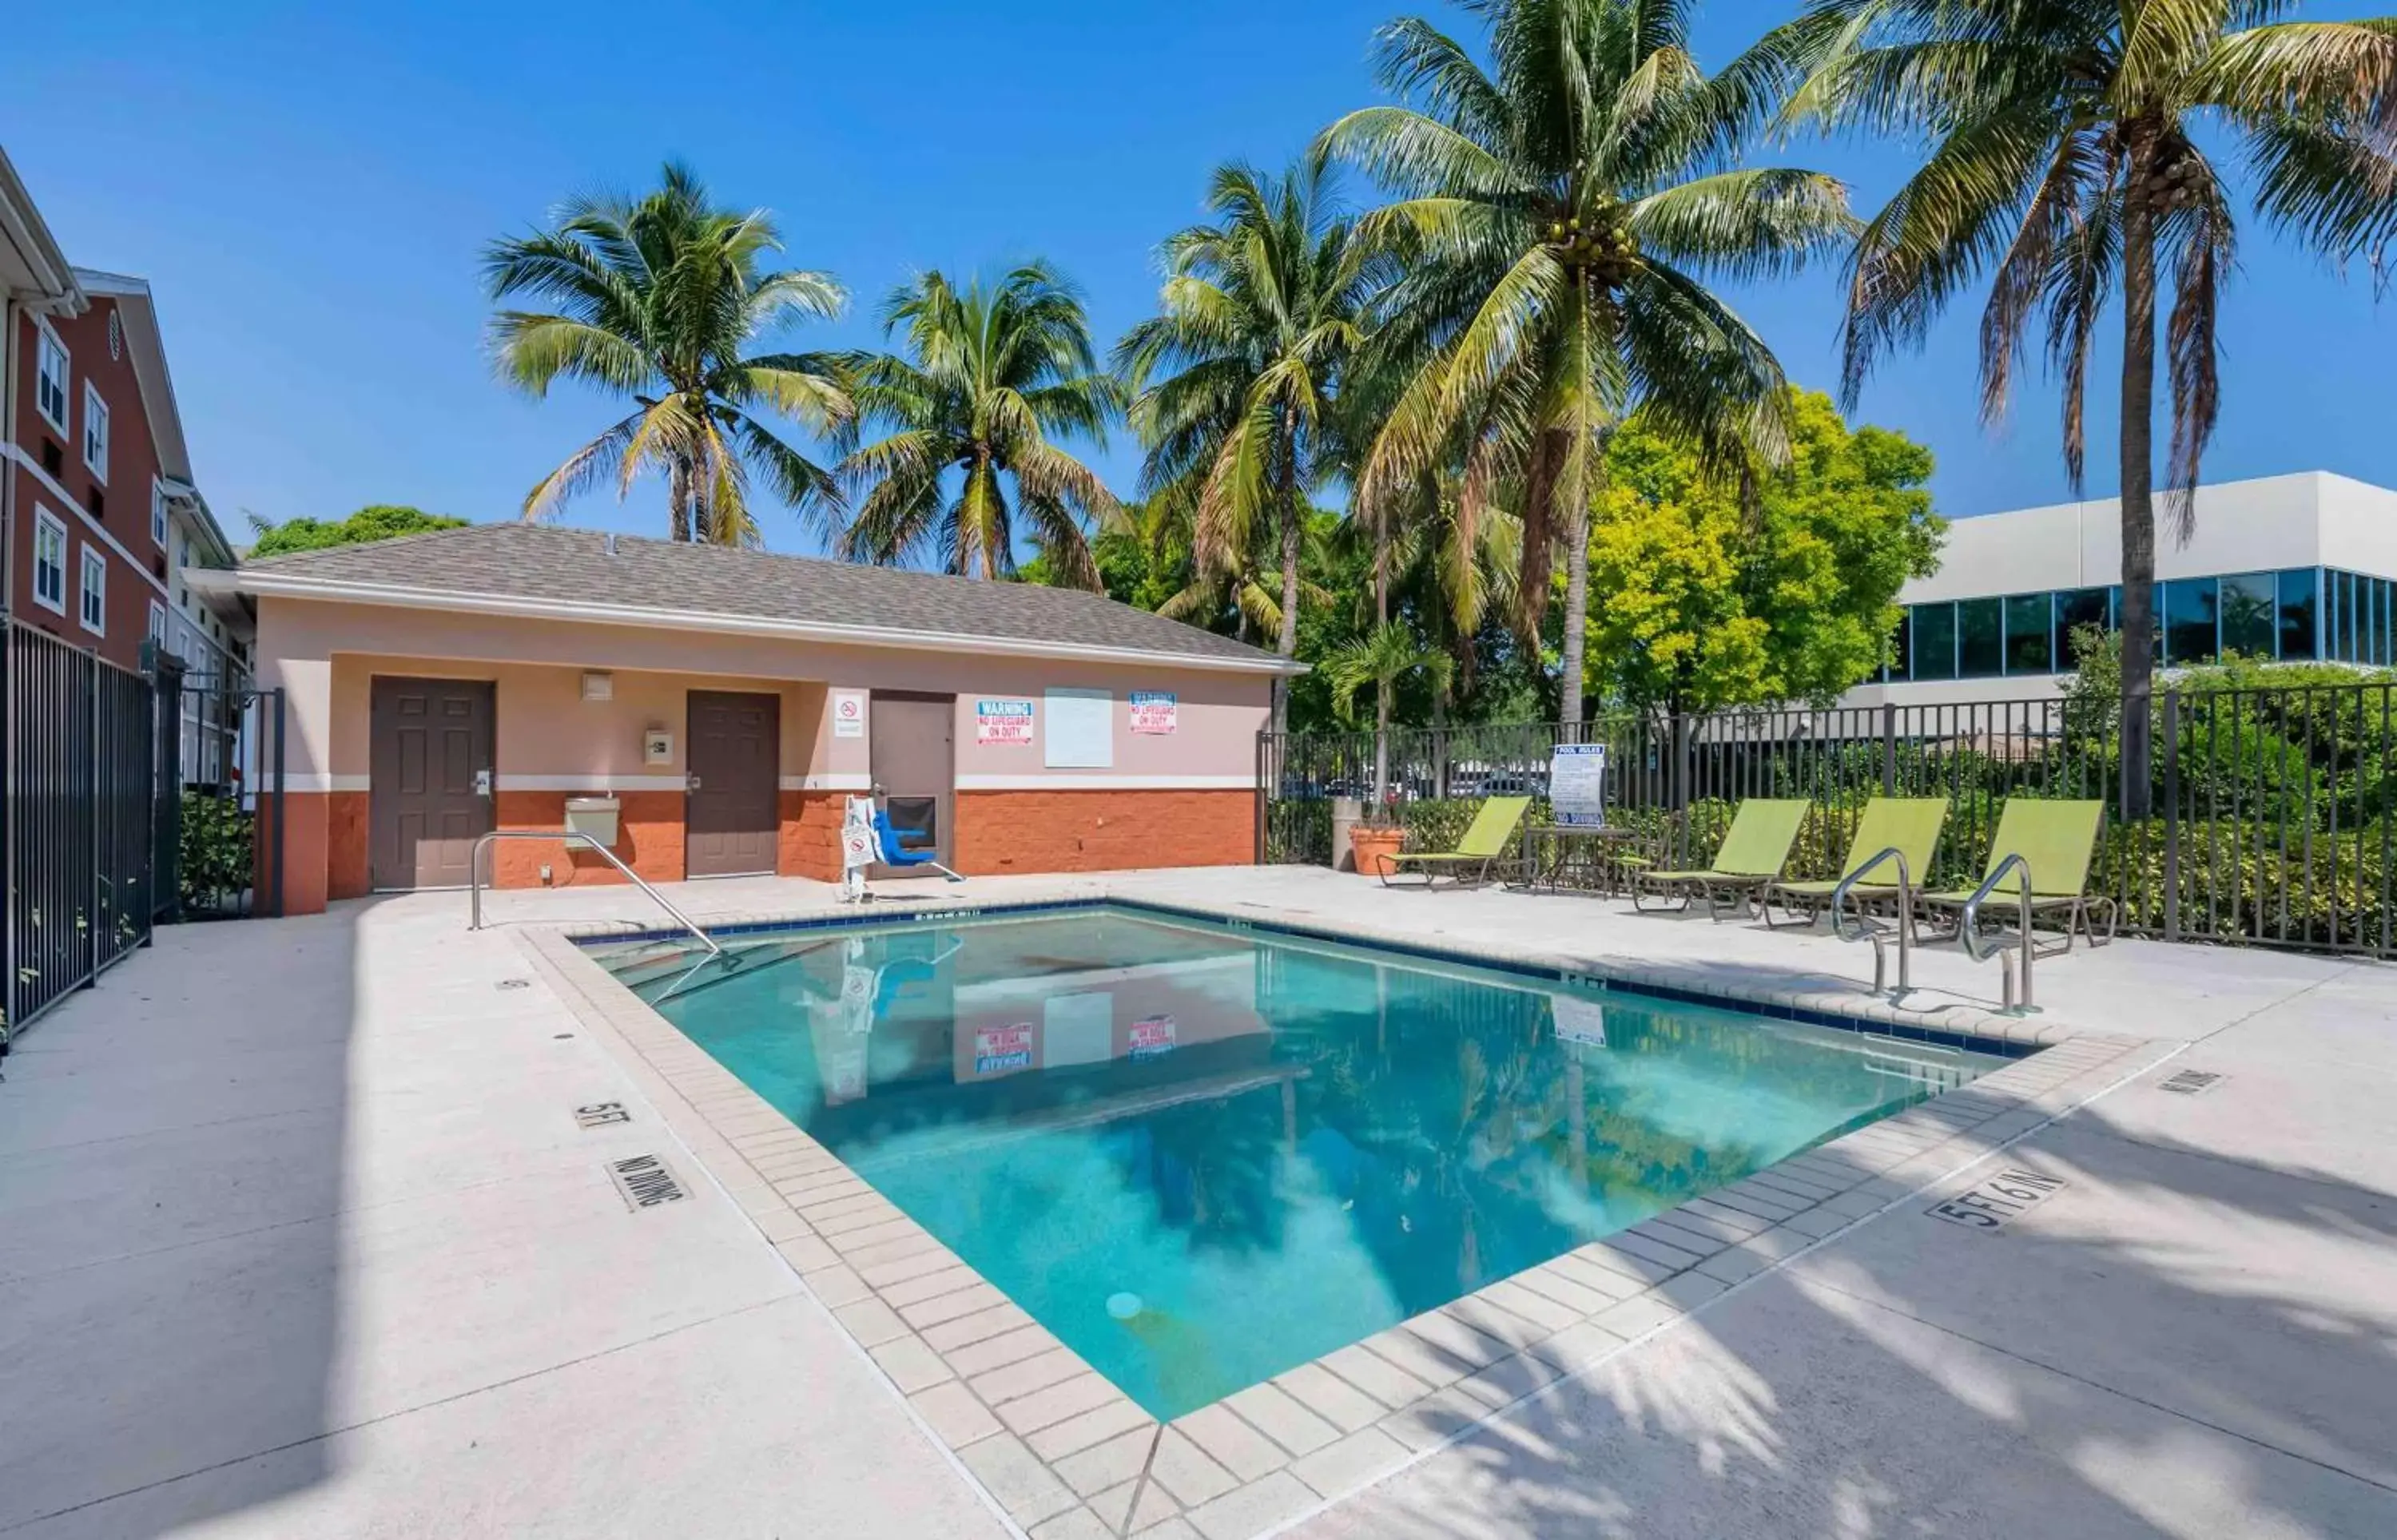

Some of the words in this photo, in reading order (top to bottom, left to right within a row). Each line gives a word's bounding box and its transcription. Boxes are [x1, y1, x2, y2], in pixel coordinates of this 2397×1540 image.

[982, 702, 1028, 716] WARNING
[1131, 705, 1139, 715] NO
[1142, 706, 1175, 716] LIFEGUARD
[979, 716, 988, 726] NO
[992, 716, 1031, 726] LIFEGUARD
[1139, 715, 1149, 724] ON
[1151, 716, 1167, 725] DUTY
[989, 726, 1000, 736] ON
[1002, 726, 1021, 736] DUTY
[1559, 746, 1576, 755] POOL
[1578, 746, 1601, 755] RULES
[613, 1154, 659, 1173] NO
[623, 1169, 684, 1207] DIVING
